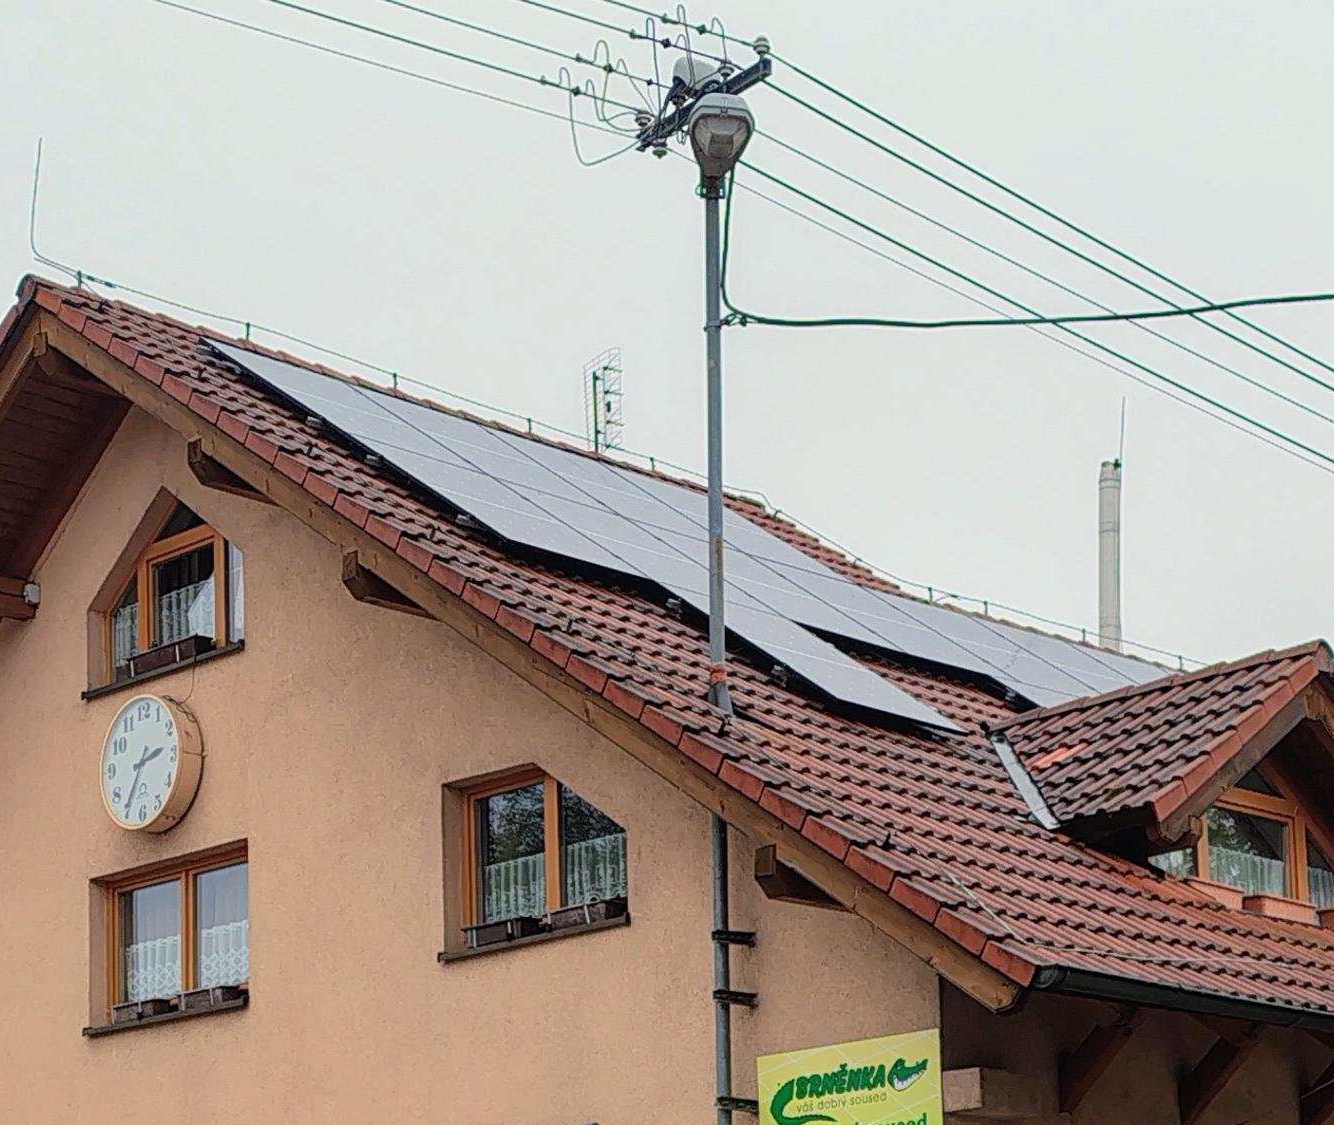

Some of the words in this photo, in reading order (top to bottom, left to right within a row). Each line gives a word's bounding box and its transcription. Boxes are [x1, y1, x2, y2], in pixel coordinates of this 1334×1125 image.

[137, 702, 151, 721] 12
[156, 705, 161, 722] 1
[123, 715, 135, 733] 11
[165, 719, 173, 737] 2
[113, 736, 127, 755] 10
[170, 744, 177, 762] 3
[107, 763, 116, 780] 9
[164, 771, 171, 788] 4
[112, 786, 121, 804] 8
[154, 794, 161, 810] 5
[139, 804, 147, 821] 6
[795, 1063, 886, 1099] BRNĚNKA
[796, 1101, 814, 1113] váš
[817, 1095, 847, 1111] dobrý
[850, 1092, 887, 1106] soused
